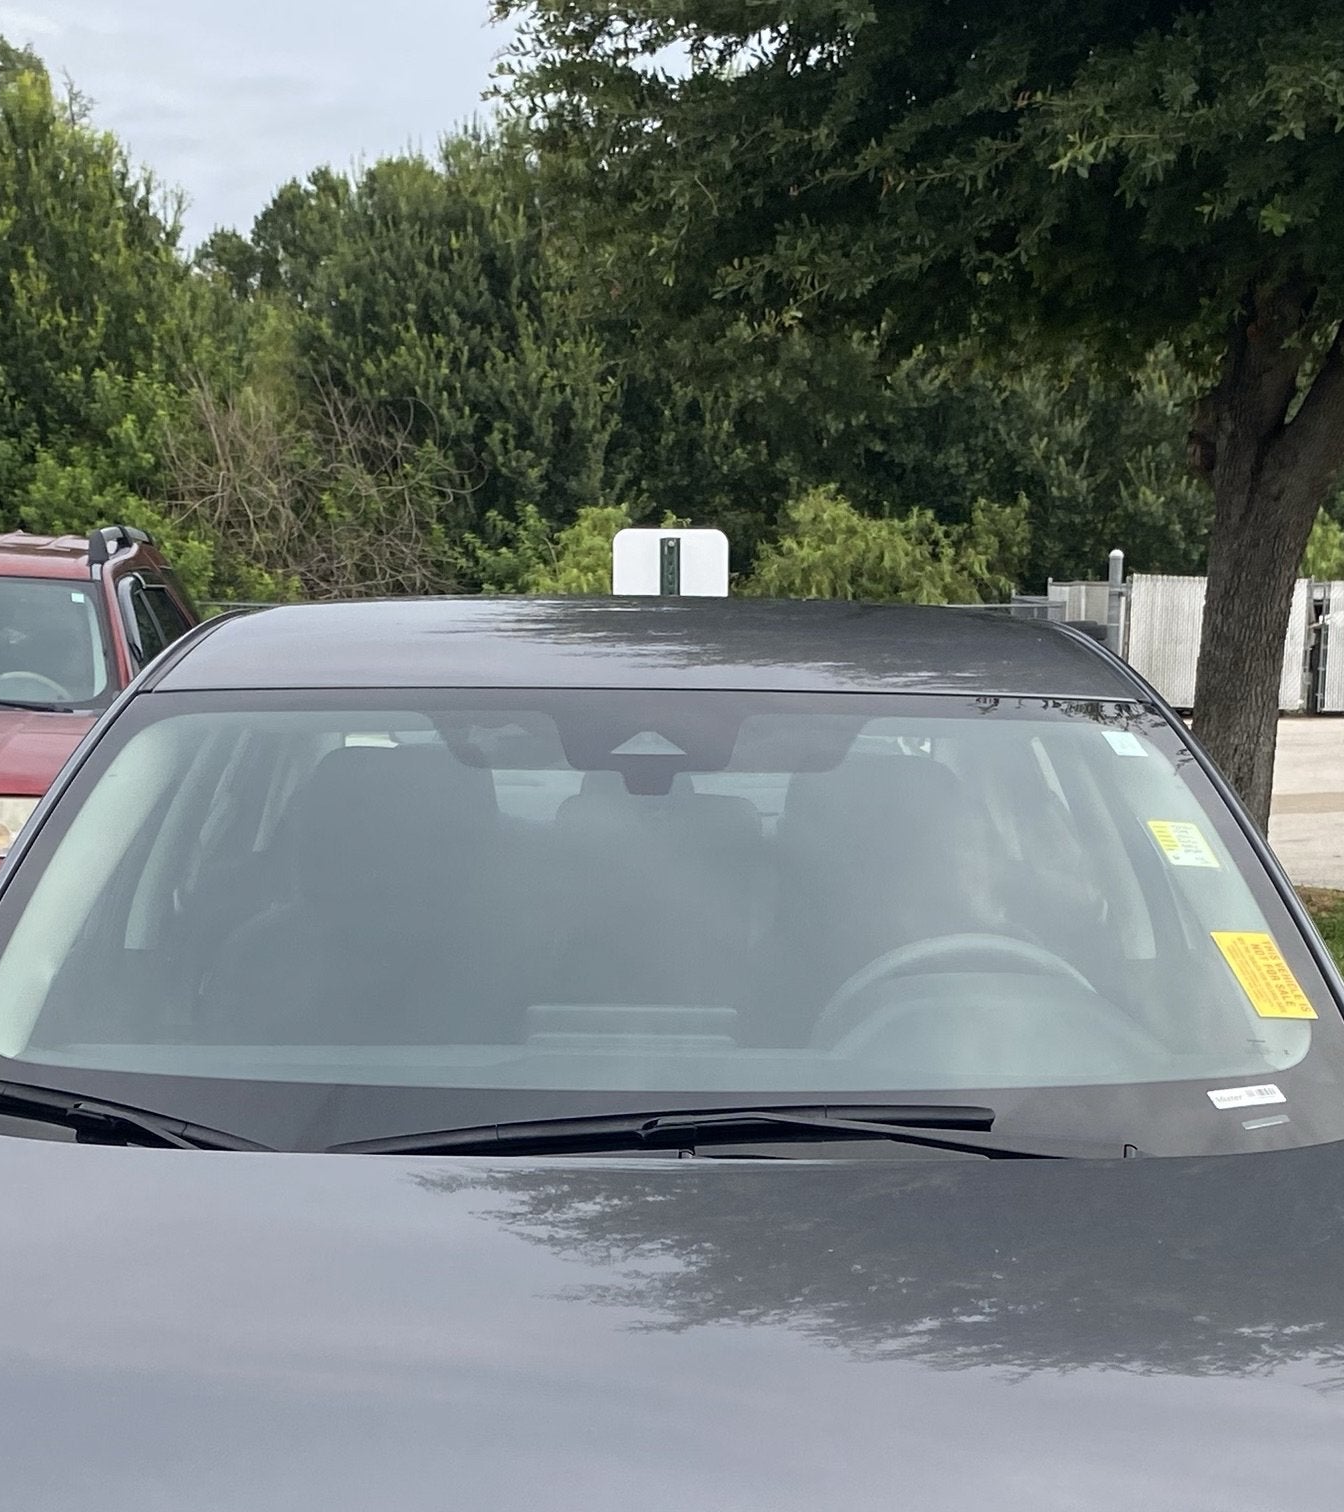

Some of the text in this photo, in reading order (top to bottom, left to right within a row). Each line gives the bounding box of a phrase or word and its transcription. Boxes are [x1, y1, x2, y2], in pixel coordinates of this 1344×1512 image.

[1250, 943, 1269, 960] NOT
[1262, 963, 1281, 981] FOR
[1274, 983, 1297, 1007] SALE
